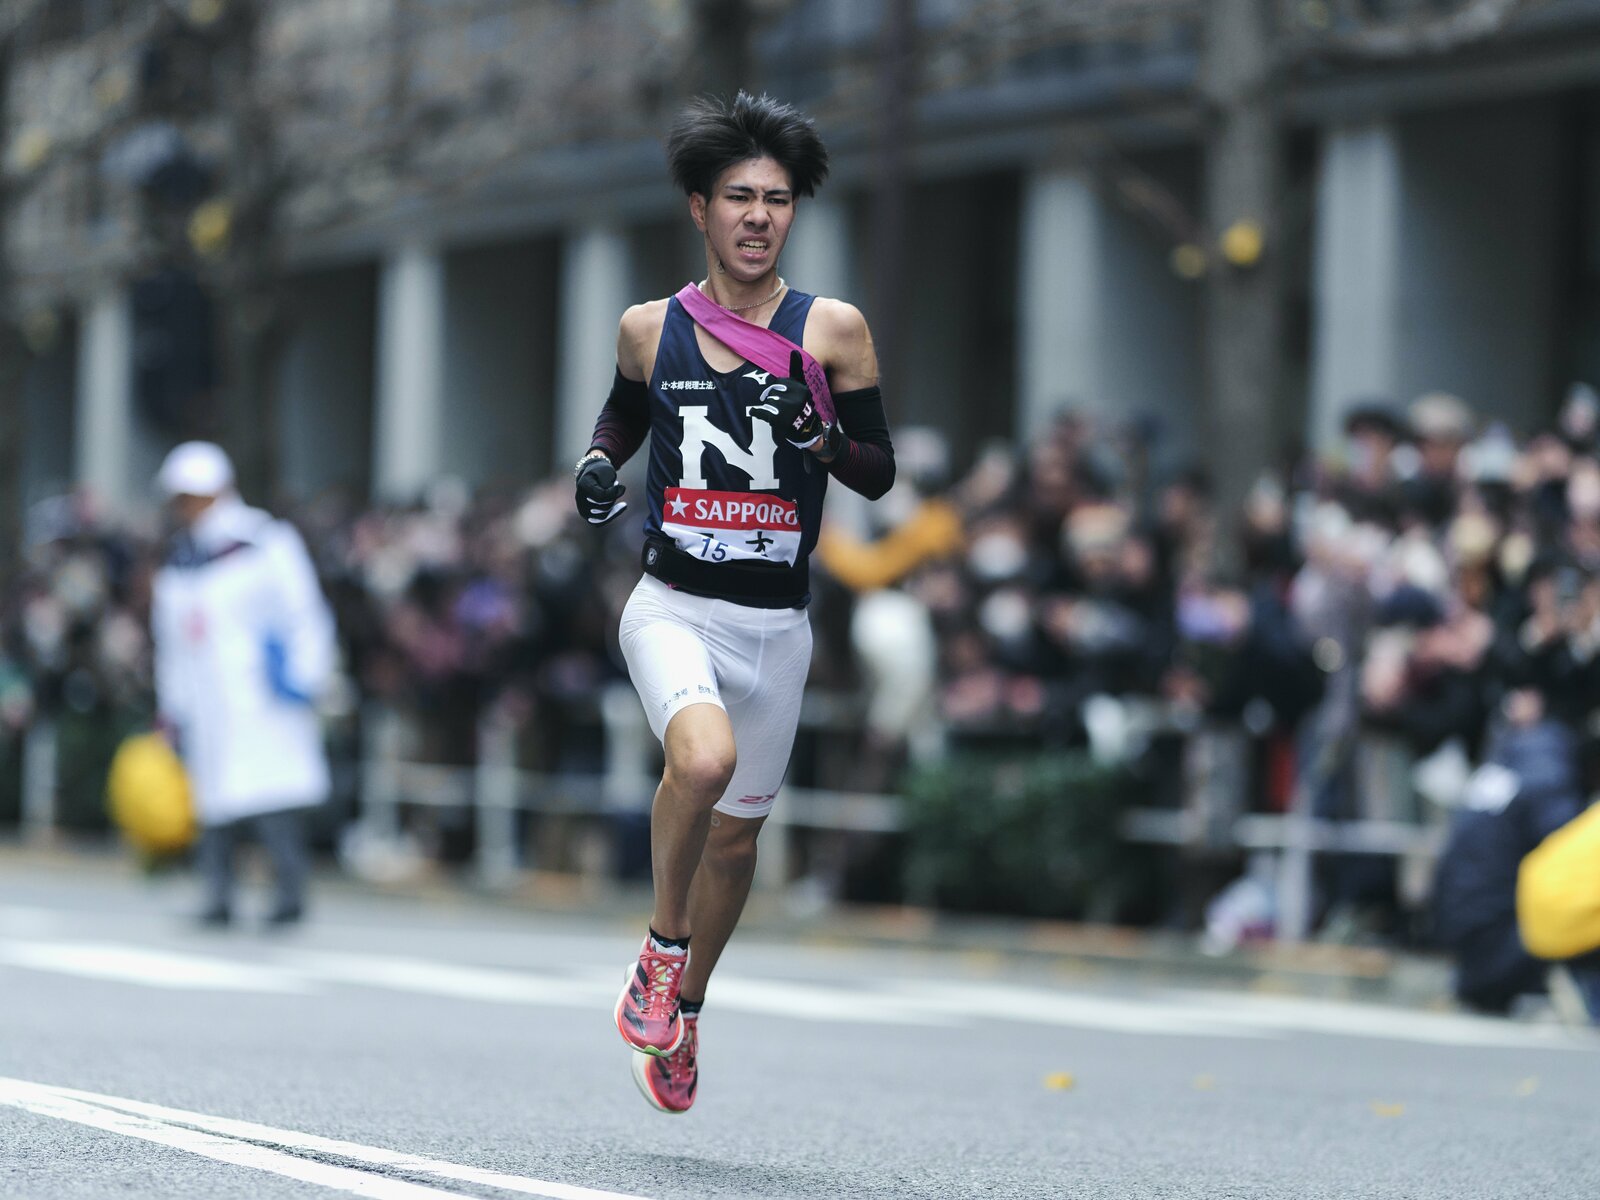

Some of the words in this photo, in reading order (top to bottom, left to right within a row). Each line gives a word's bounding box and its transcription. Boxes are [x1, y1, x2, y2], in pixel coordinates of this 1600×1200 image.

[678, 405, 780, 490] N
[694, 498, 799, 526] SAPPORO
[700, 537, 728, 562] 15
